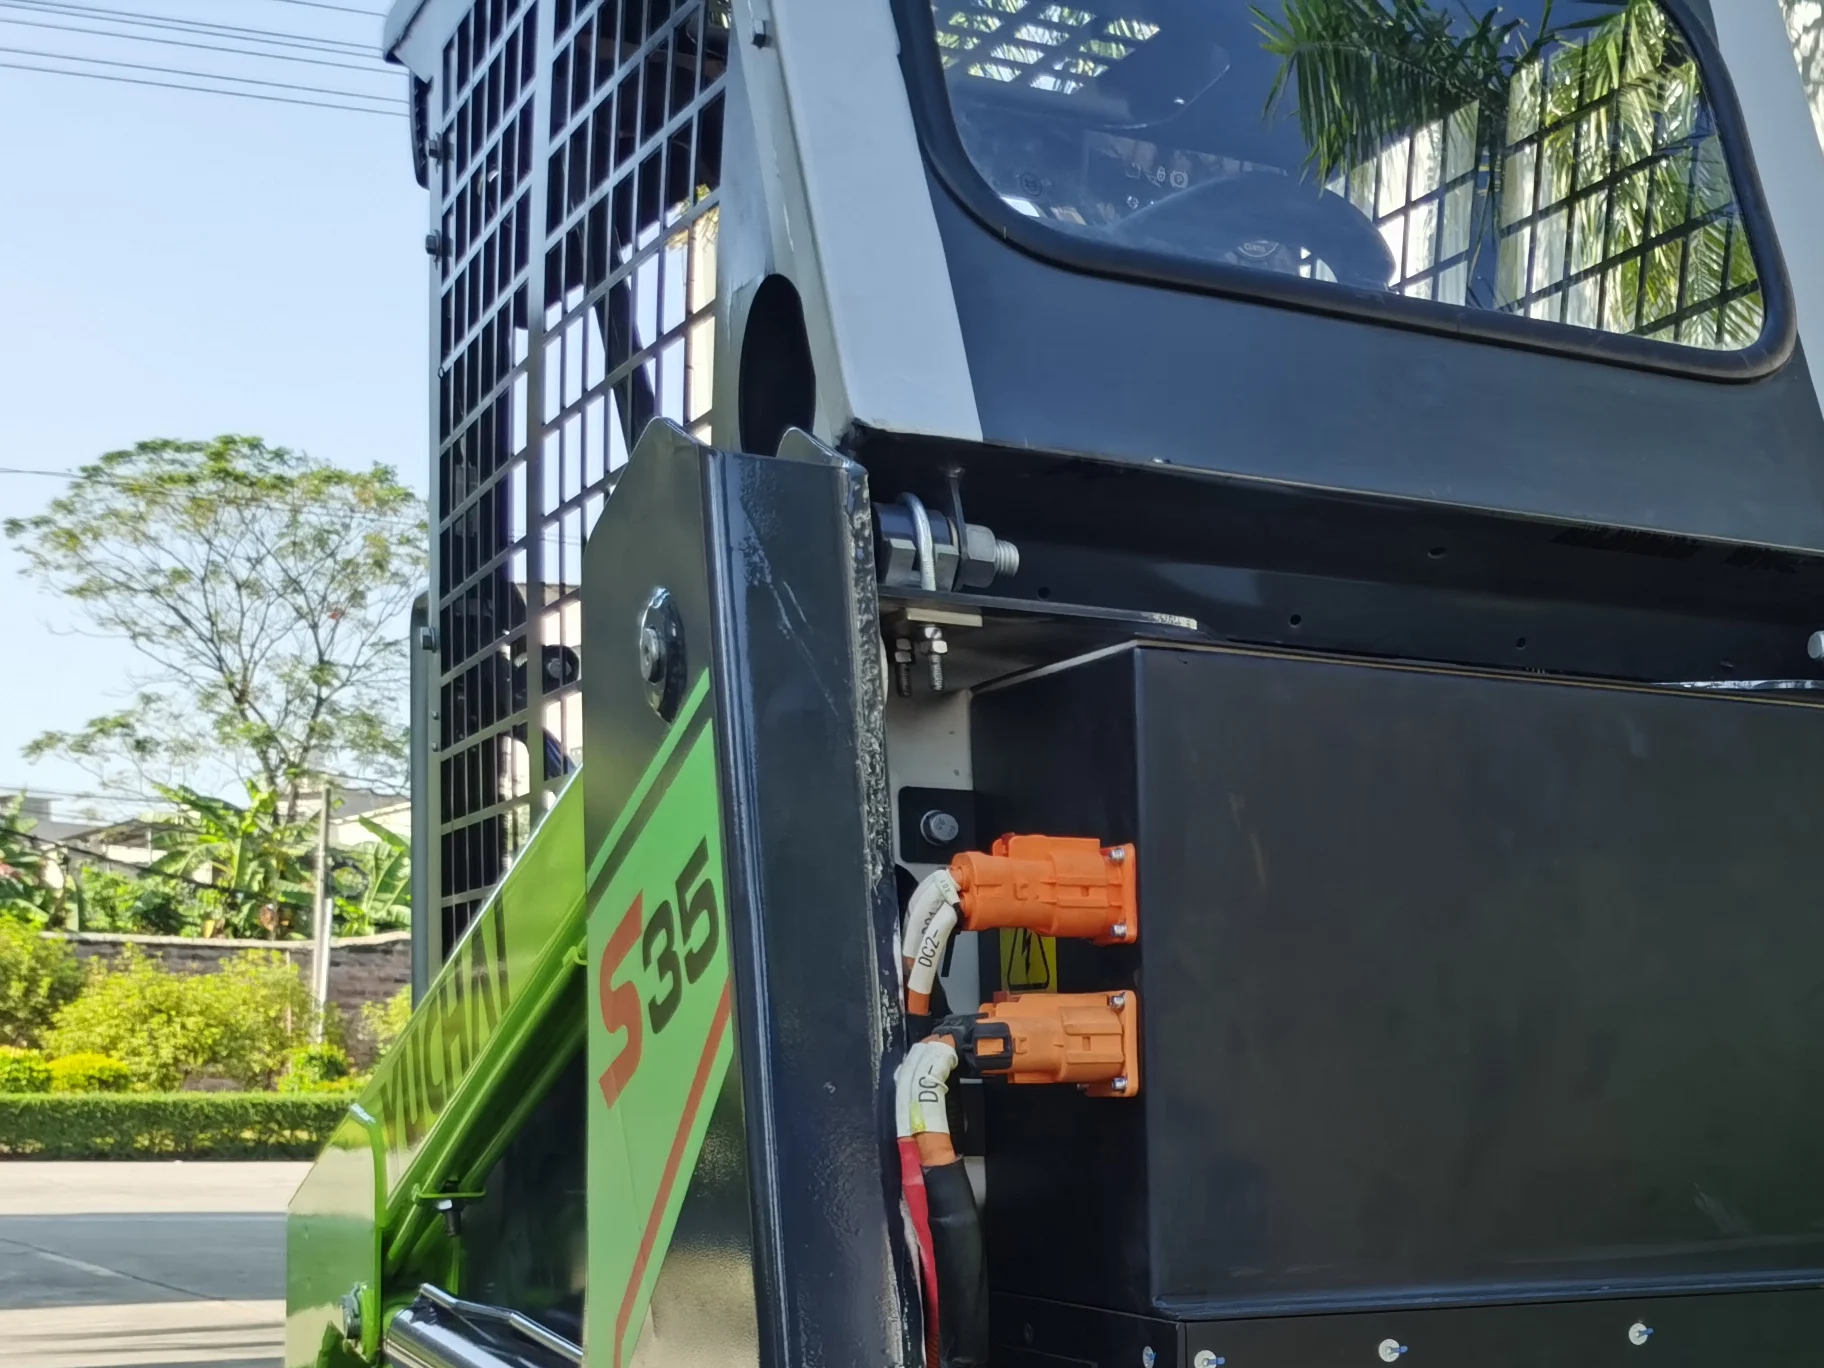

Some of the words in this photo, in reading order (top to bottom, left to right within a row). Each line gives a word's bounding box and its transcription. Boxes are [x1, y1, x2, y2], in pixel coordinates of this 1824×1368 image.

[918, 929, 940, 968] DC2-
[598, 835, 720, 1110] S35
[918, 1064, 939, 1103] DC-
